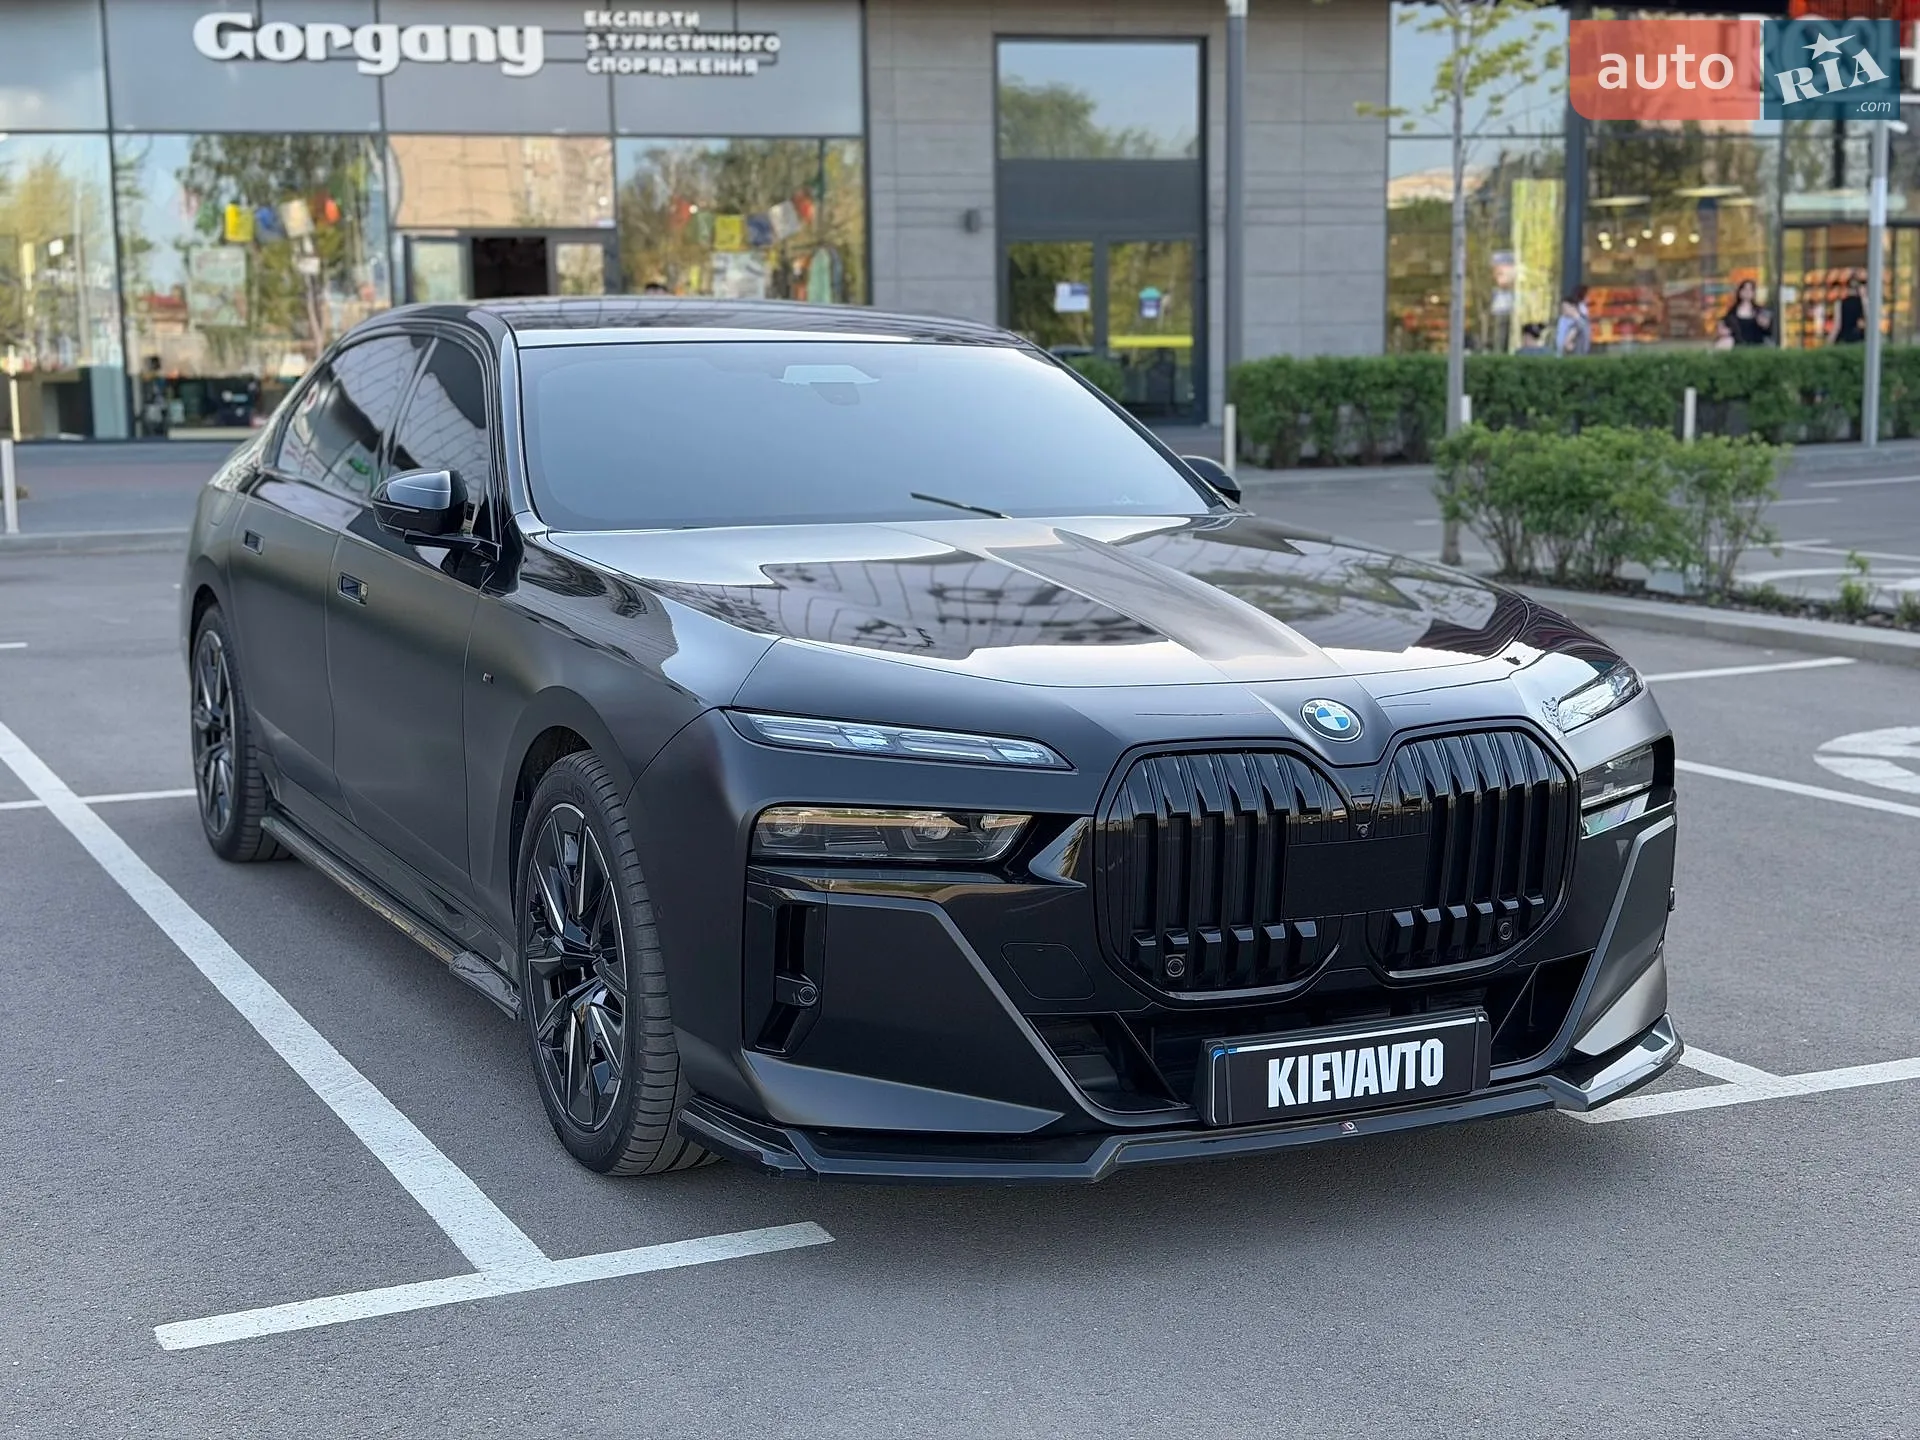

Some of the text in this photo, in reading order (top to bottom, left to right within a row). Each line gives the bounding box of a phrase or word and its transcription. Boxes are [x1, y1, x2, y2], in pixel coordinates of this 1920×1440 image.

[584, 11, 700, 27] ЕКСПЕРТИ
[193, 12, 544, 76] Gorgany
[605, 35, 781, 51] ТУРИСТИЧНОГО
[586, 57, 759, 75] СПОРЯДЖЕННЯ
[1268, 1038, 1444, 1108] KIEVAVTO
